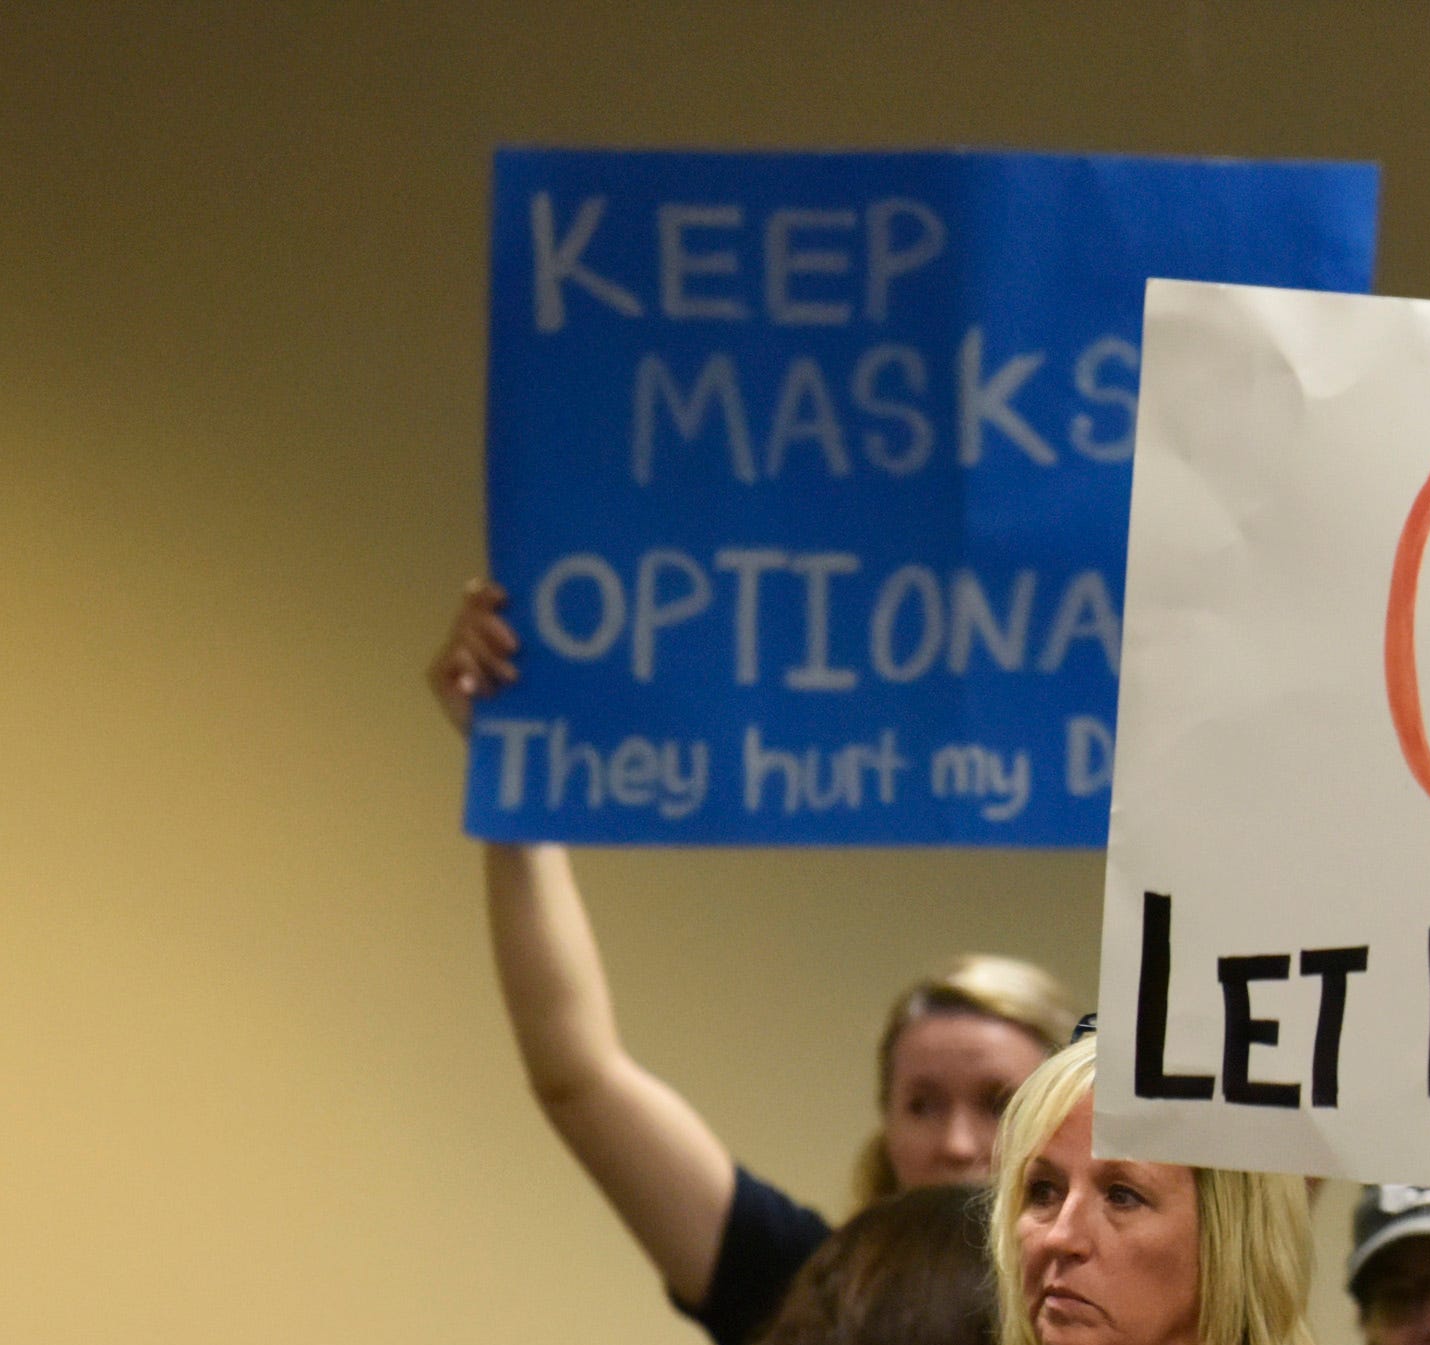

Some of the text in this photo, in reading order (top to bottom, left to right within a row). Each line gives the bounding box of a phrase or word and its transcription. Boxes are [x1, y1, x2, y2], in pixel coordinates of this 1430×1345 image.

[530, 191, 946, 334] KEEP
[632, 326, 1140, 486] MASKS
[534, 547, 1122, 690] OPTIONA
[479, 719, 709, 818] They
[743, 723, 905, 812] hurt
[930, 742, 1030, 820] my
[1132, 892, 1369, 1110] LET
